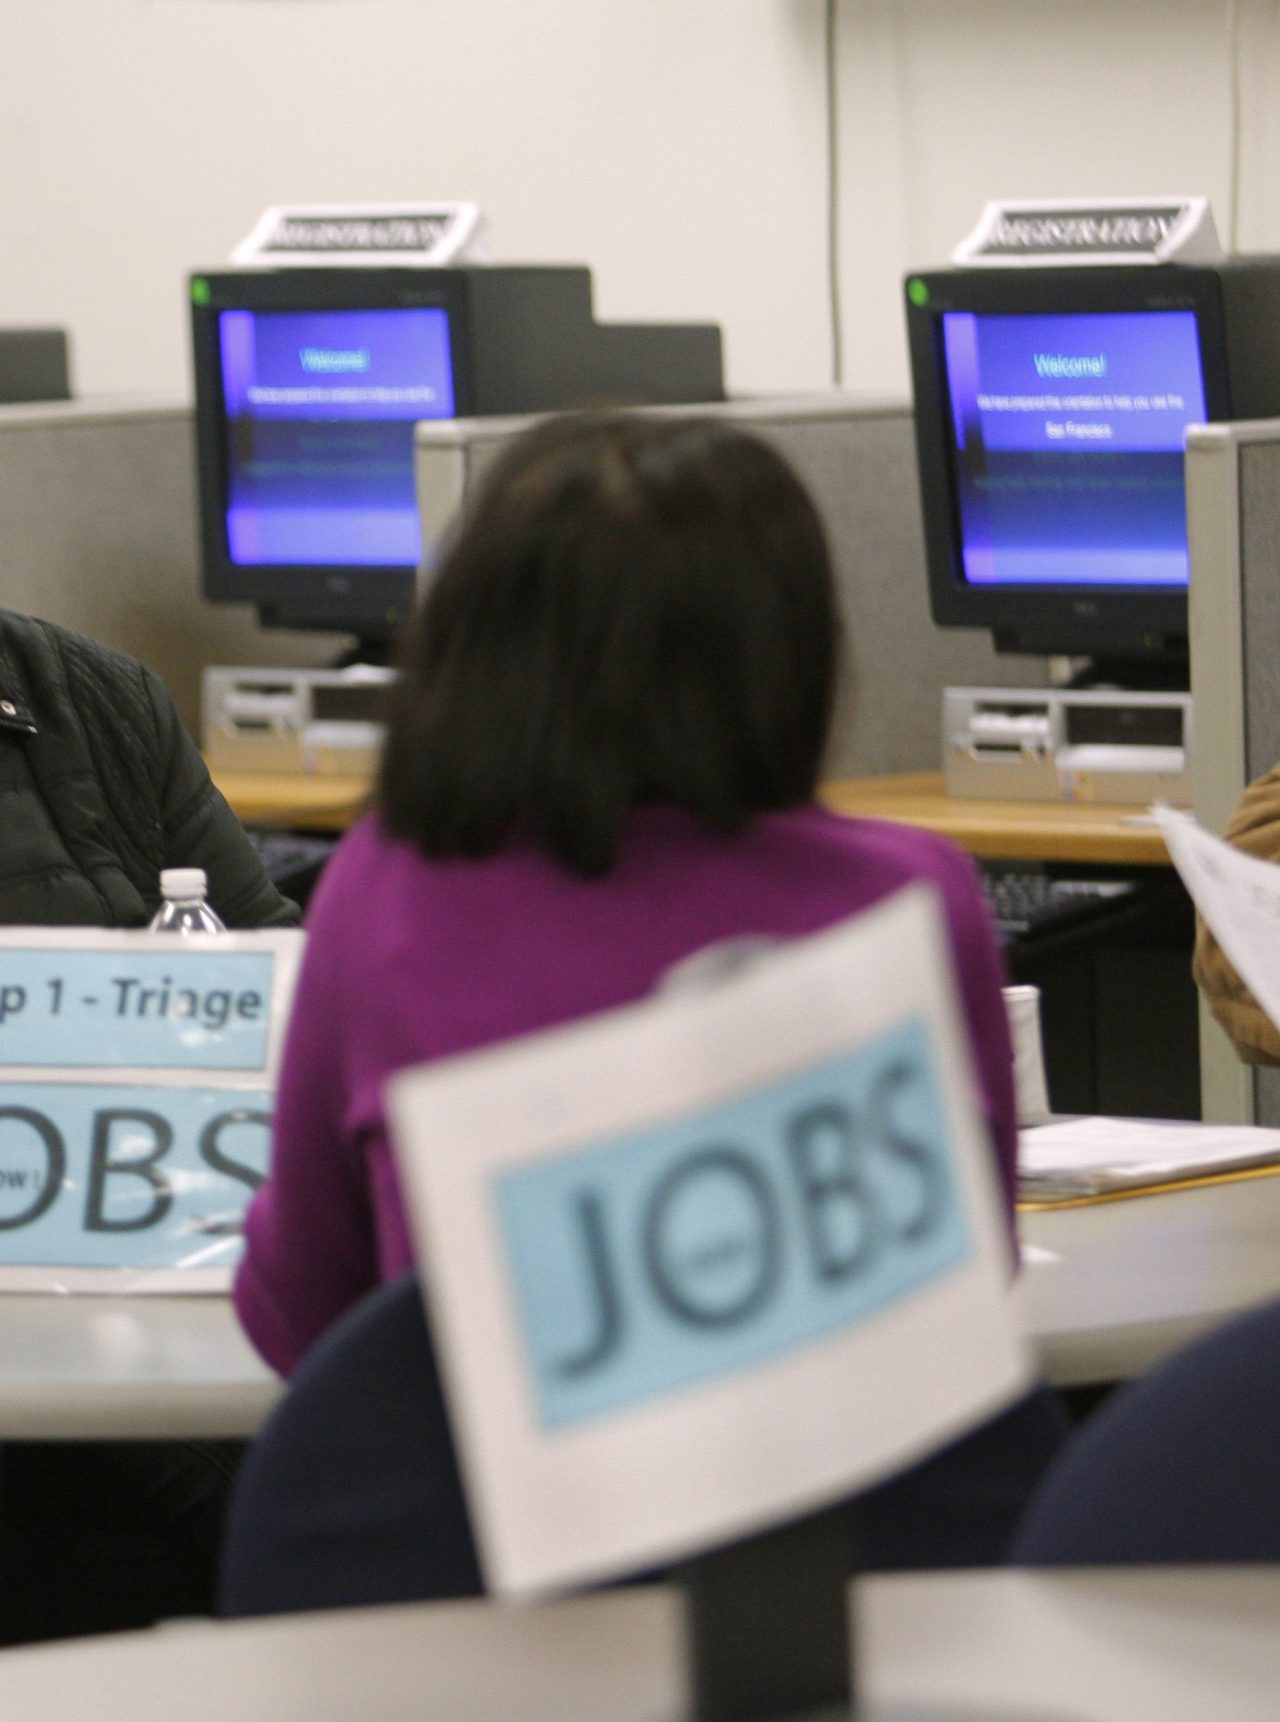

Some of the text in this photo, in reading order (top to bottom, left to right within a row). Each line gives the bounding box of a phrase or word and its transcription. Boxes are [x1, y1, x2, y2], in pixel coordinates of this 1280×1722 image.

[46, 977, 65, 1014] 1
[112, 977, 262, 1030] Triage
[550, 1058, 952, 1380] JOBS
